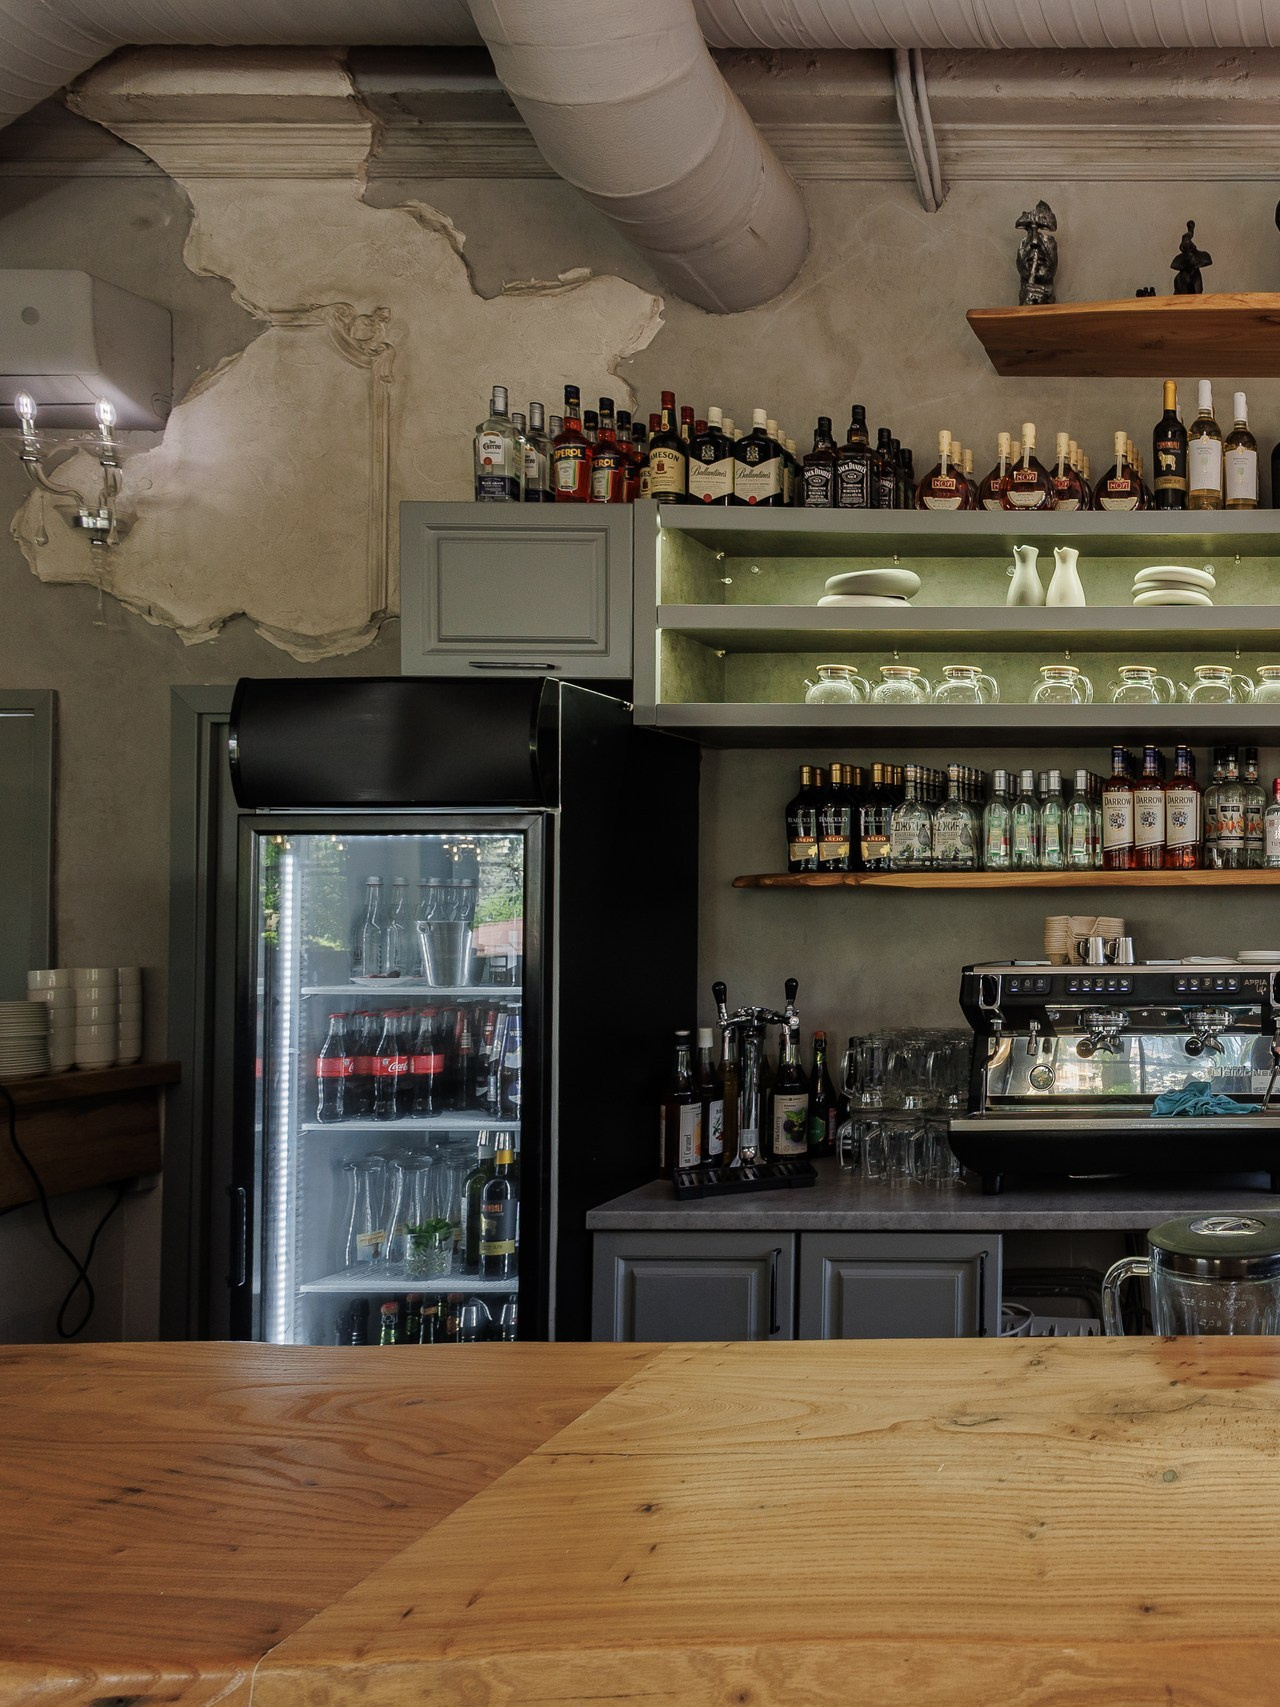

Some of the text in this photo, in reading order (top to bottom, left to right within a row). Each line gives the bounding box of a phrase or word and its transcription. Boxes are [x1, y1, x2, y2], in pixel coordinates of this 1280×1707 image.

[1104, 796, 1132, 806] DARROW
[1136, 795, 1163, 805] DARROW
[1167, 795, 1194, 805] DARROW
